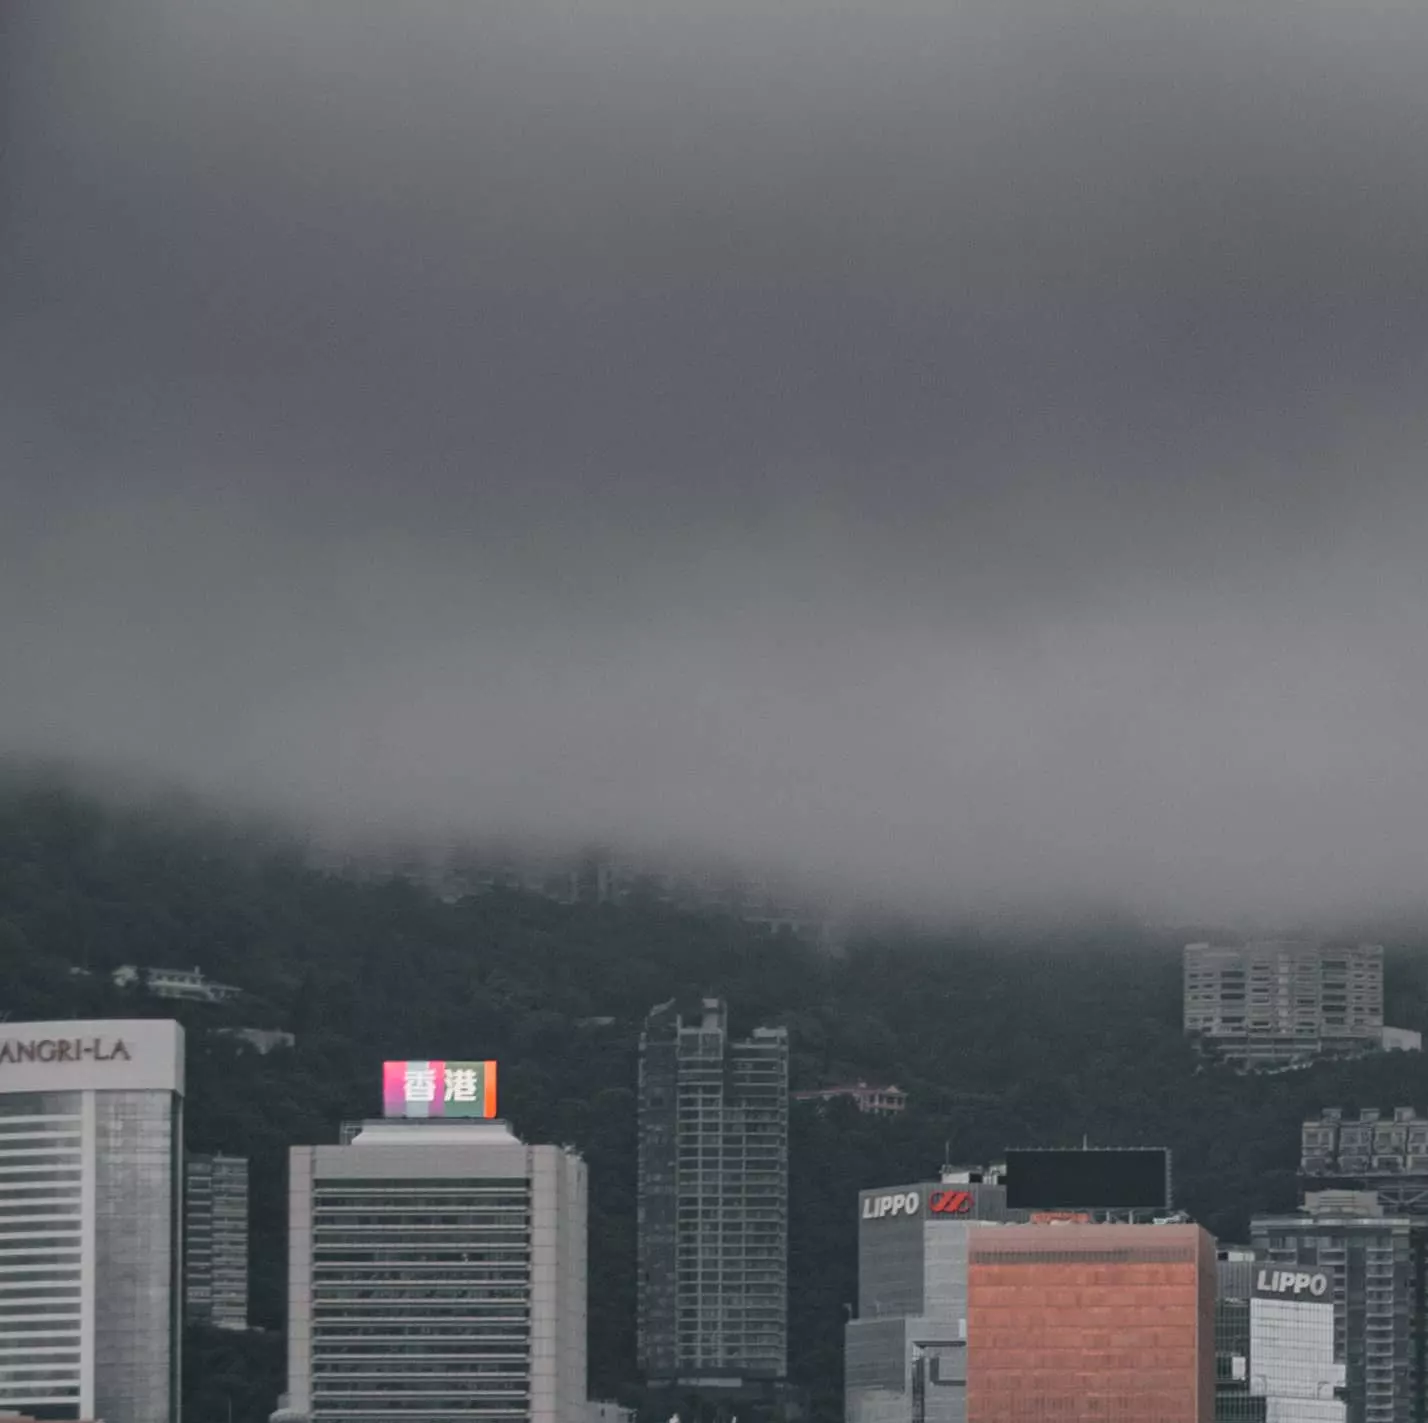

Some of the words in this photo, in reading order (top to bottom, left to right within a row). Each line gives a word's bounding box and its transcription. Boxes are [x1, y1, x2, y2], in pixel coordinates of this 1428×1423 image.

[403, 1068, 477, 1102] 香港
[863, 1192, 919, 1218] LIPPO
[1257, 1269, 1327, 1296] LIPPO
